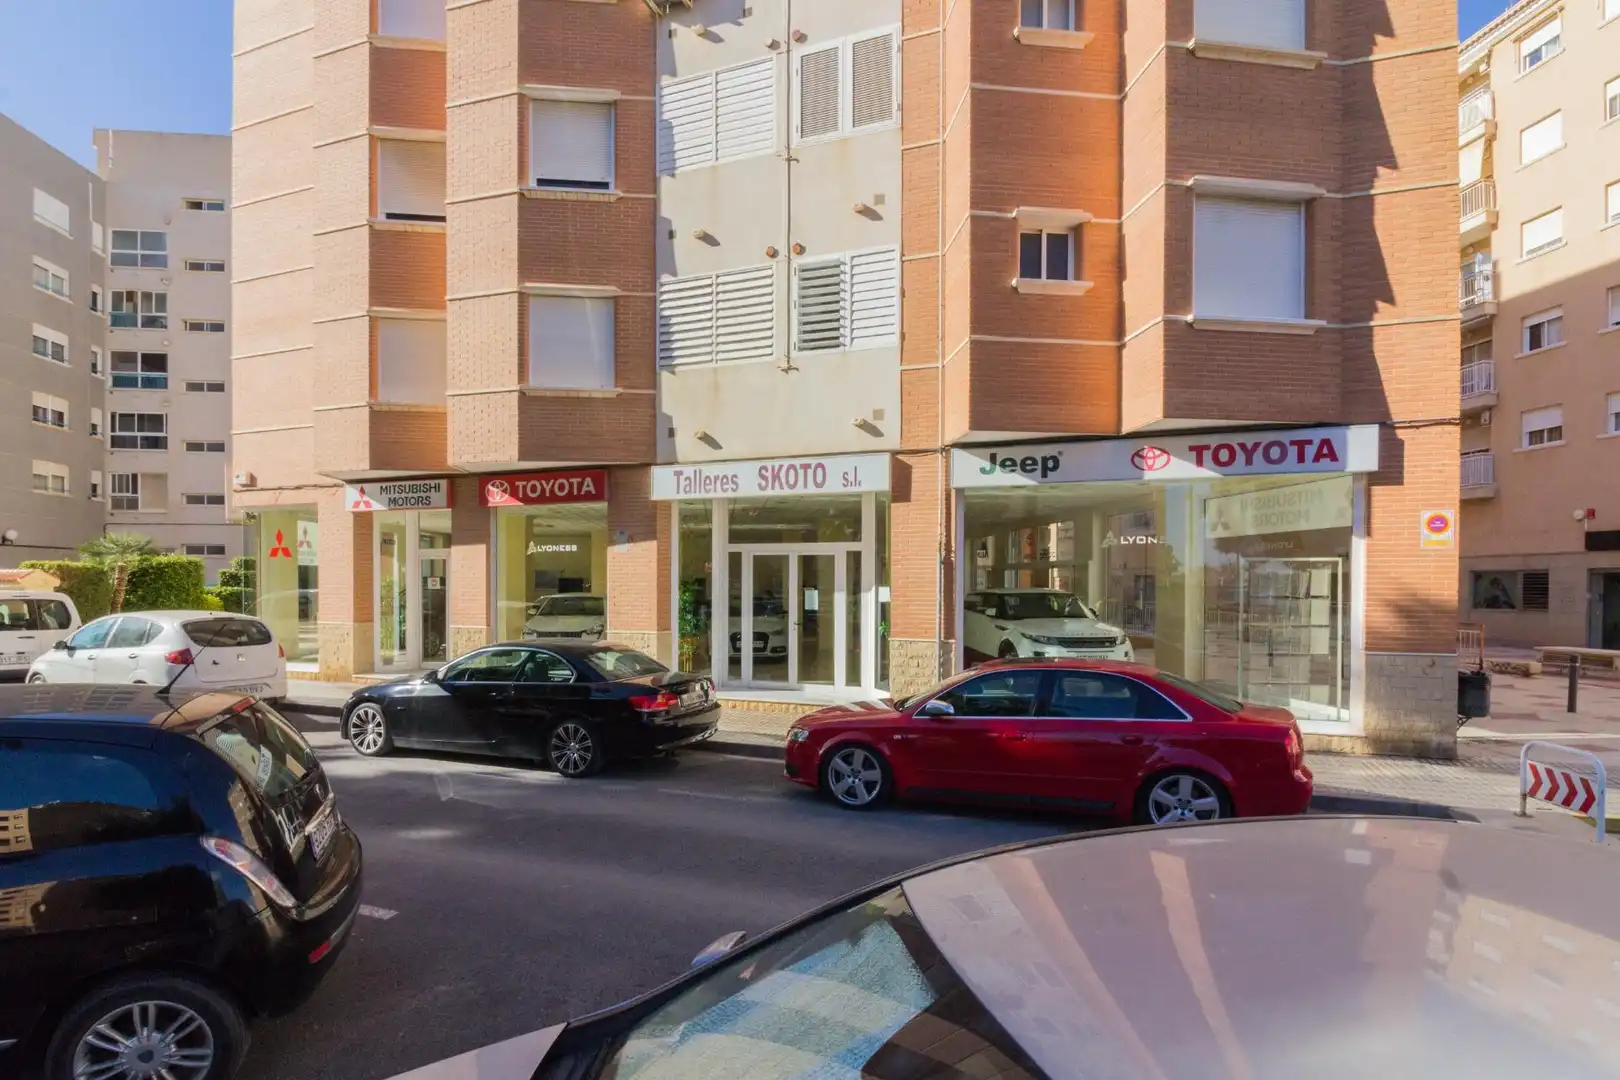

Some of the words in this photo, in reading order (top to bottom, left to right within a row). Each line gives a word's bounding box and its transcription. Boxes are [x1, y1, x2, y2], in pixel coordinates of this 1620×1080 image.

[1188, 438, 1339, 468] TOYOTA
[979, 452, 1060, 478] Jeep
[379, 482, 440, 495] MITSUBISHI
[515, 477, 596, 498] TOYOTA
[673, 469, 739, 494] Talleres
[757, 462, 827, 491] SKOTO
[842, 466, 862, 488] s.l.
[388, 495, 432, 507] MOTORS
[537, 544, 577, 552] LYONESS
